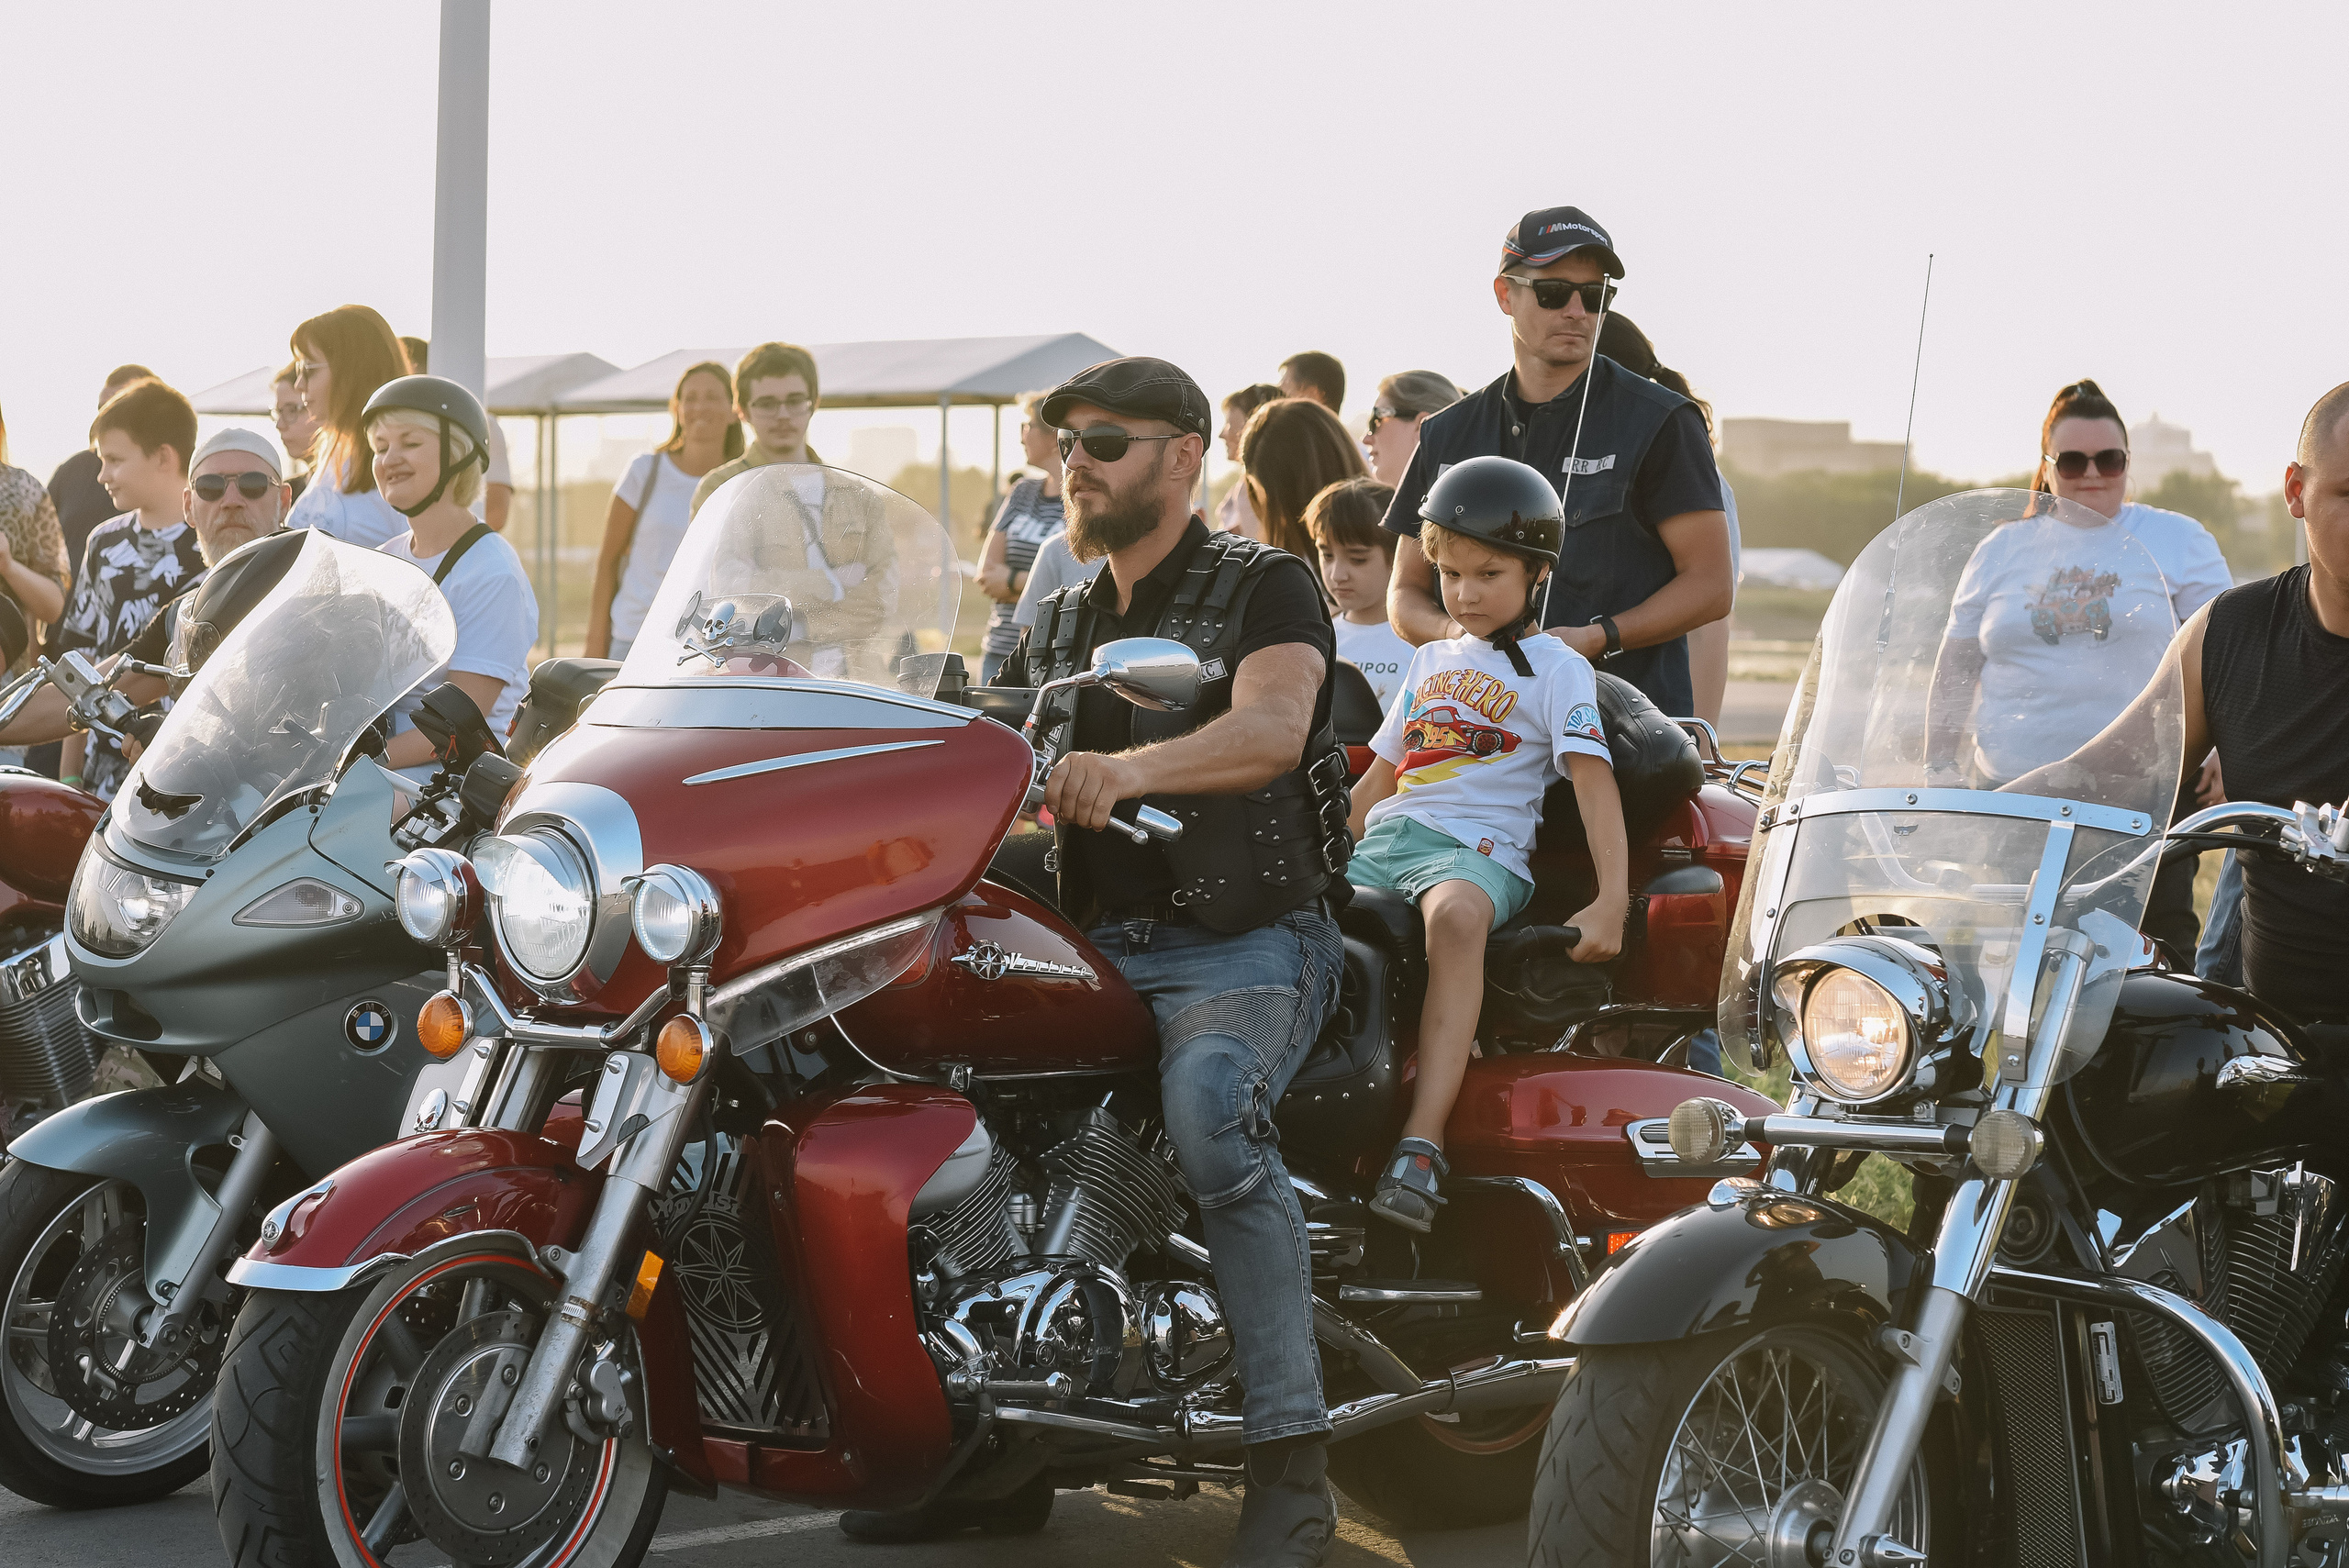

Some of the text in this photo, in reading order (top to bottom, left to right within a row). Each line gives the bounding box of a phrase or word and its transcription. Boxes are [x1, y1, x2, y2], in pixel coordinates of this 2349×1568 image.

[1452, 668, 1520, 724] HERO
[1566, 709, 1584, 729] TOP
[1422, 726, 1450, 750] 95
[351, 1003, 389, 1019] BMW
